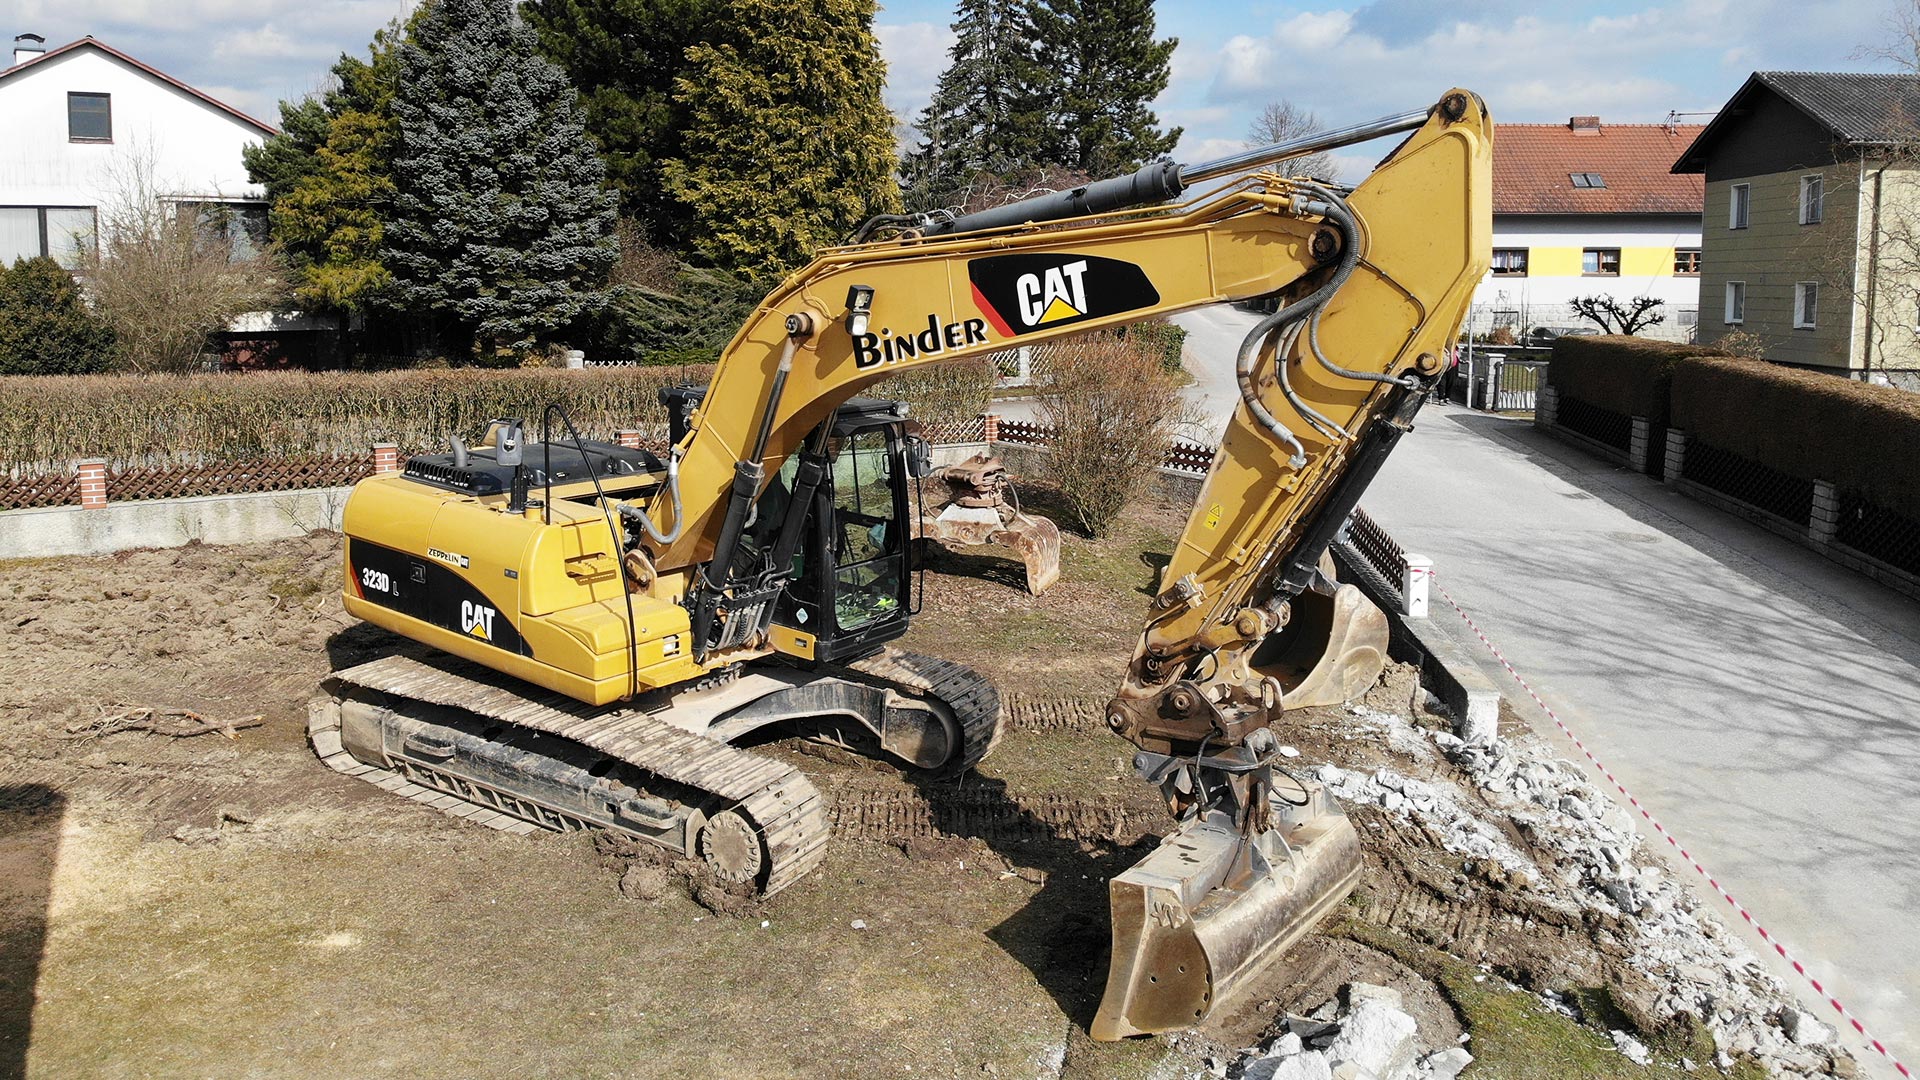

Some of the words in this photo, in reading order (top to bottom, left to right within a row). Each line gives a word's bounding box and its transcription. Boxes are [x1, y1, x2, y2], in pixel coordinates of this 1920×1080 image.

[1016, 260, 1088, 327] CAT
[428, 547, 460, 564] ZEPPELIN
[362, 567, 389, 593] 323D
[393, 580, 399, 596] L
[461, 600, 495, 641] CAT
